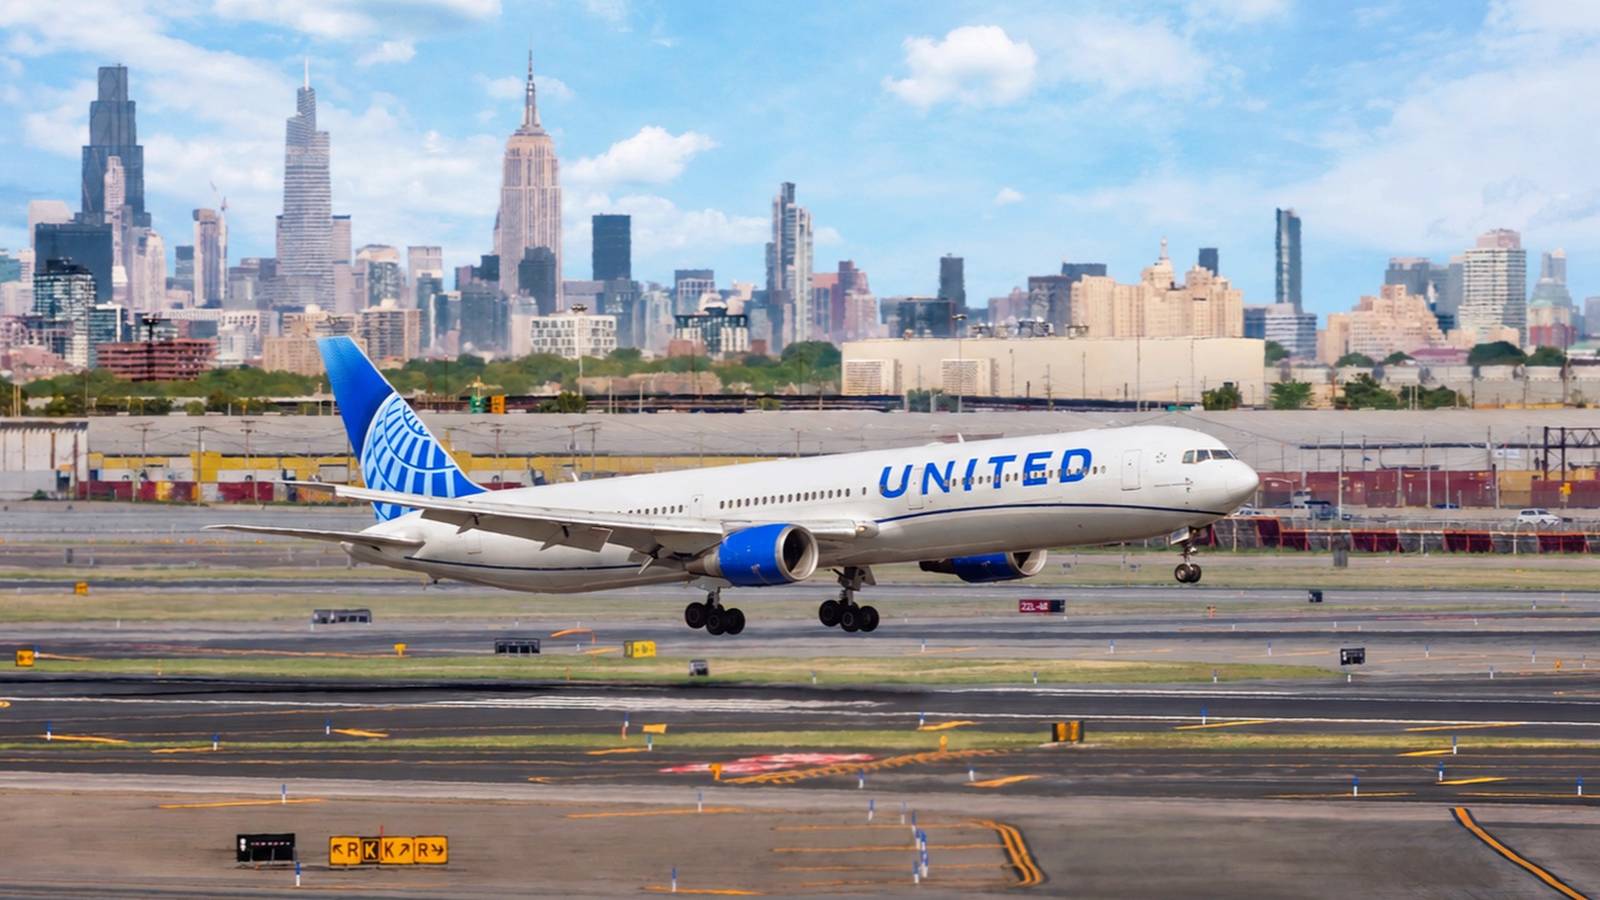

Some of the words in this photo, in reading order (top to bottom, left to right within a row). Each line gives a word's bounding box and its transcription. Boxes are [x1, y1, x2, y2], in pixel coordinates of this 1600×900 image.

[879, 448, 1092, 499] UNITED
[347, 842, 358, 857] R
[365, 842, 376, 858] K
[384, 842, 394, 858] K
[418, 843, 428, 857] R
